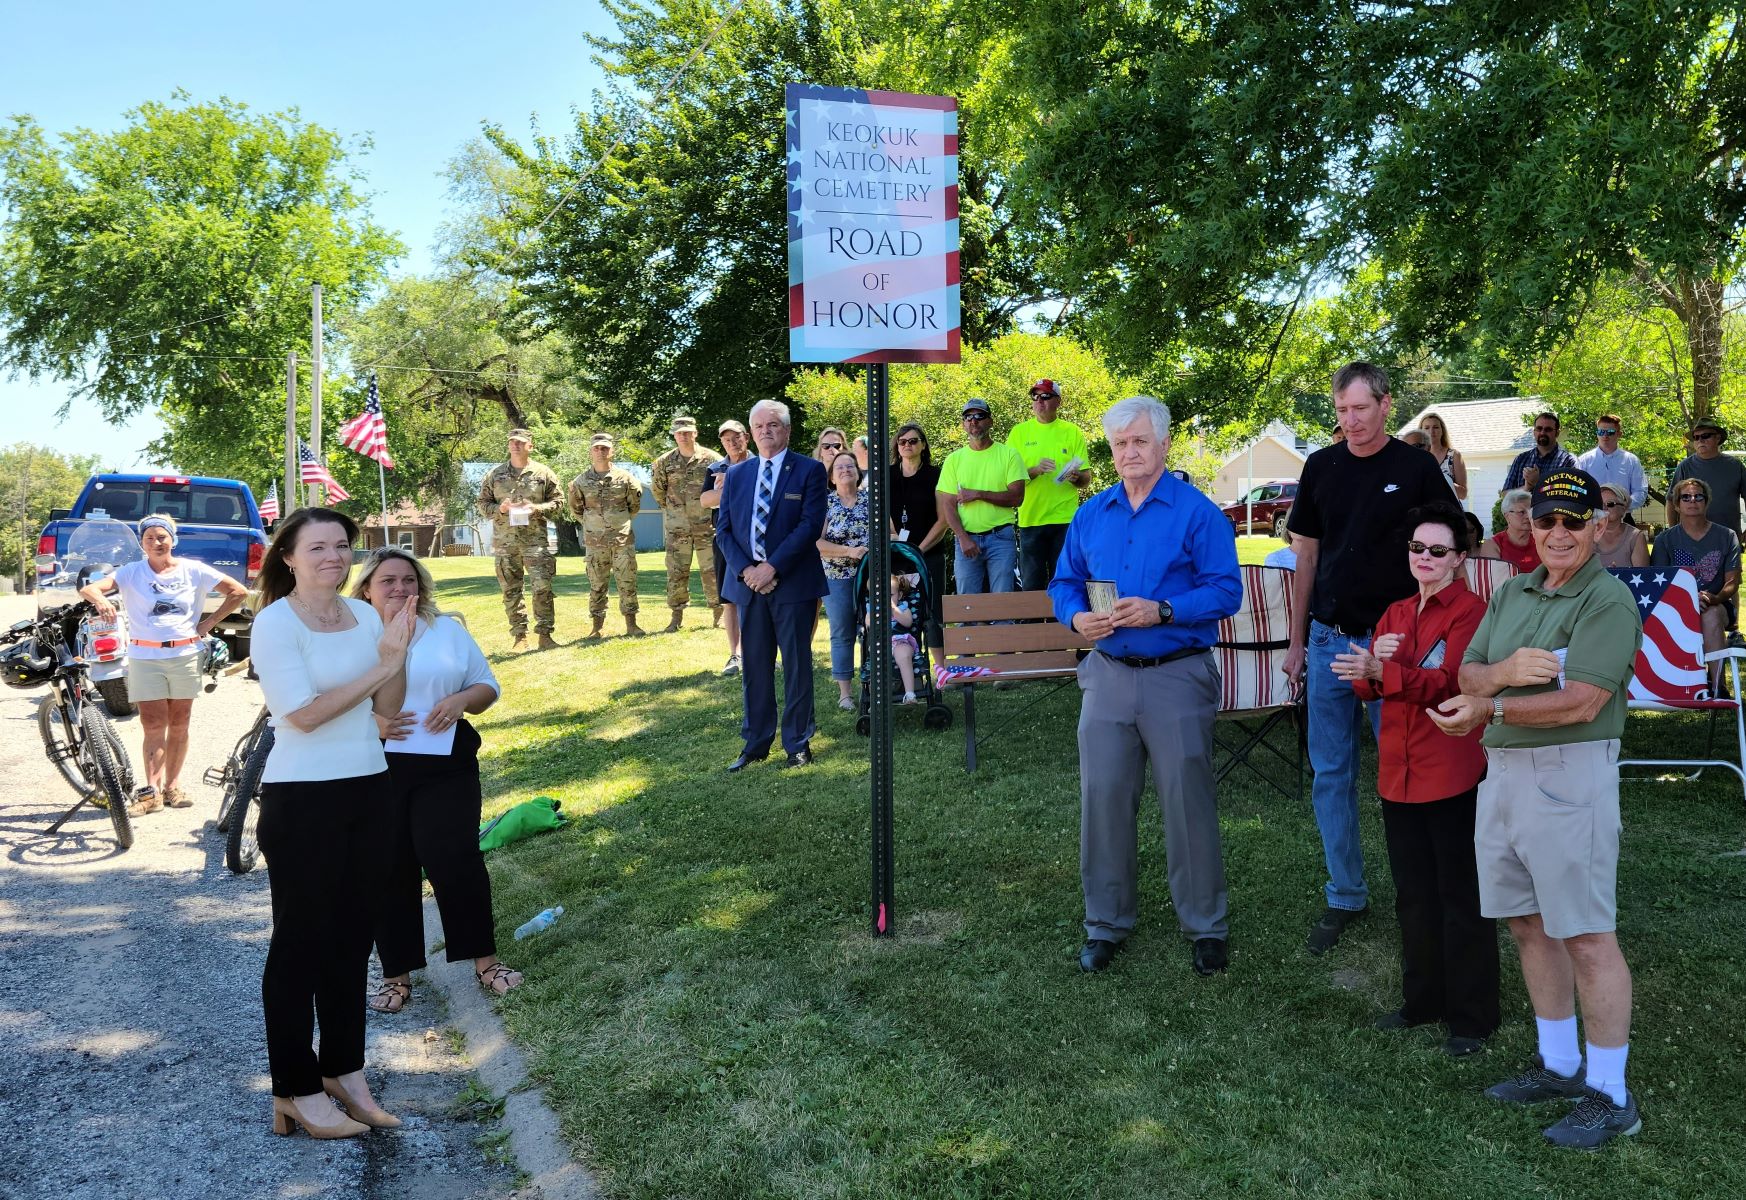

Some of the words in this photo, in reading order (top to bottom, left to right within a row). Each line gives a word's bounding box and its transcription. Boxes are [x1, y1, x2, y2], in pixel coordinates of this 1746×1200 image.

[827, 121, 919, 147] KEOKUK
[814, 150, 931, 175] NATIONAL
[814, 177, 932, 203] CEMETERY
[828, 226, 923, 260] ROAD
[862, 272, 890, 291] OF
[811, 300, 940, 330] HONOR
[1544, 472, 1586, 486] VIETNAM
[1546, 490, 1579, 498] VETERAN
